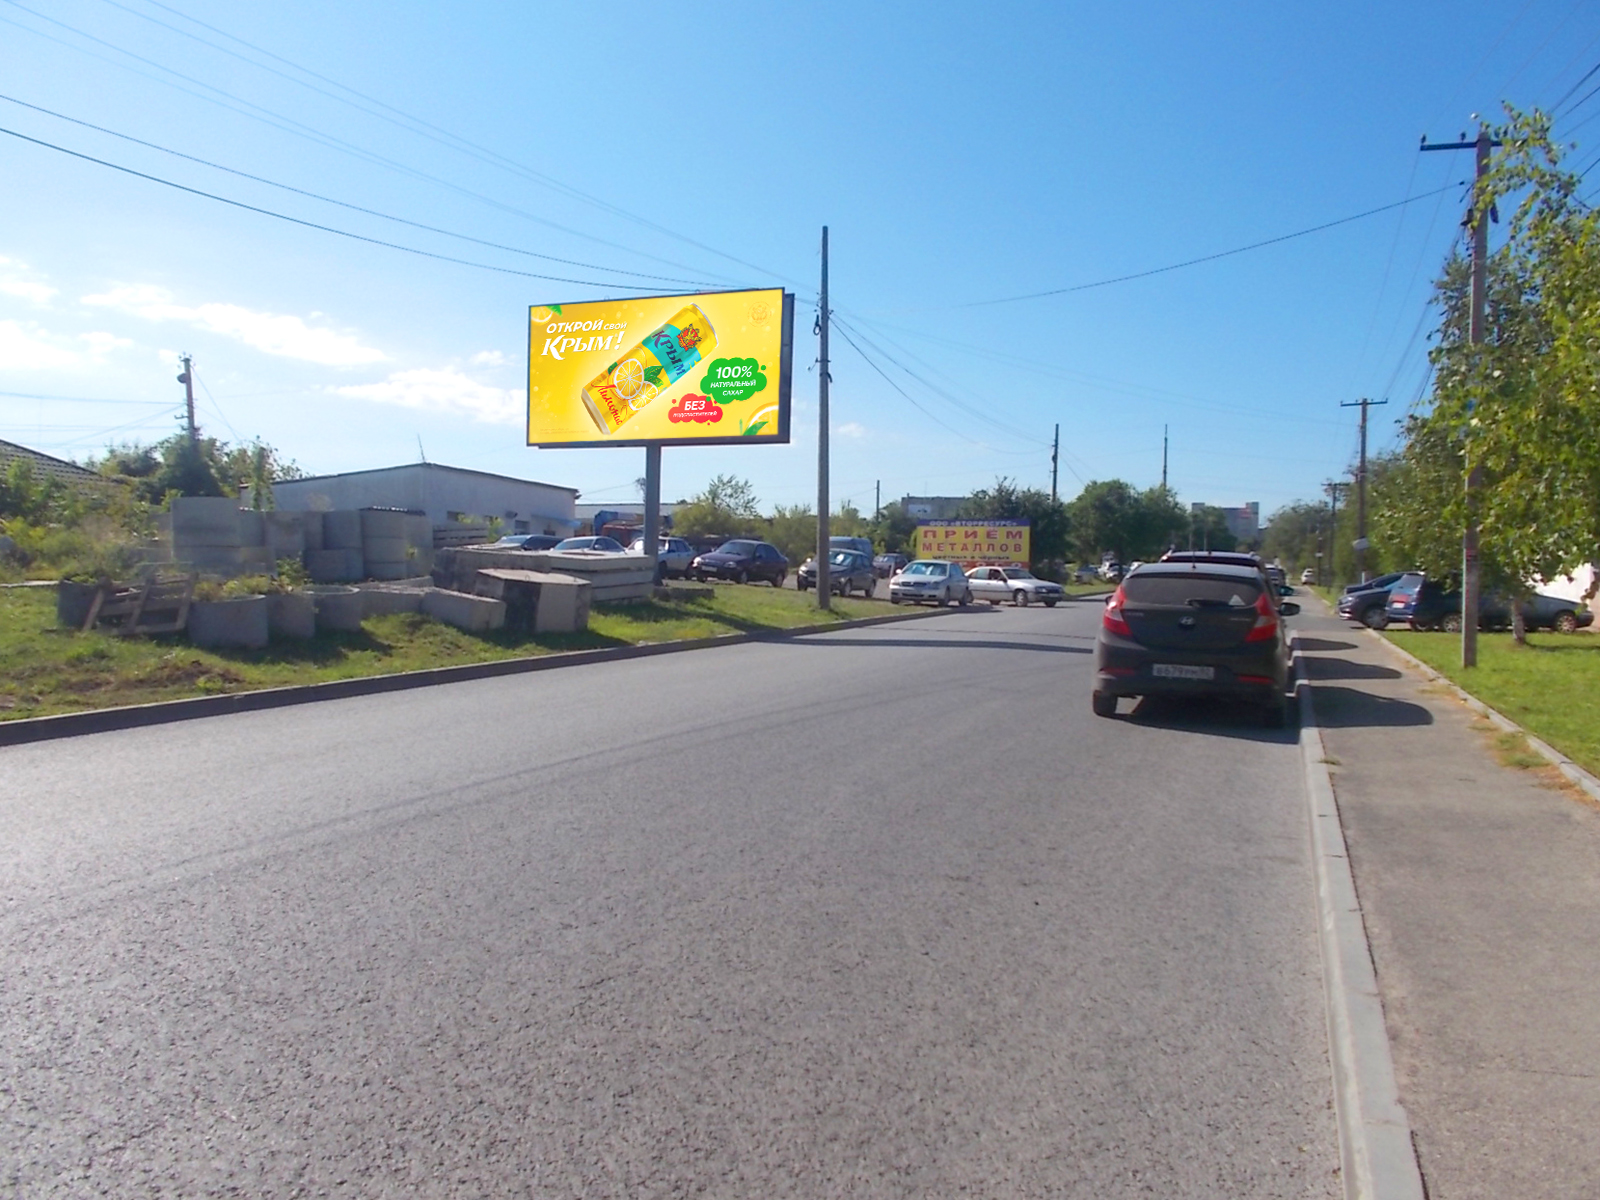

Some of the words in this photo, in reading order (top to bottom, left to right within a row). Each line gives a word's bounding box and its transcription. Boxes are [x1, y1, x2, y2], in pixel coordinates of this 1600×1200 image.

[546, 319, 604, 334] ОТКРОЙ
[716, 365, 753, 379] 100%
[710, 379, 757, 388] НАТУРАЛЬНЫЙ
[684, 400, 706, 411] БЕЗ
[923, 527, 1023, 540] ПРИЁМ
[922, 542, 1023, 553] МЕТАЛЛОВ
